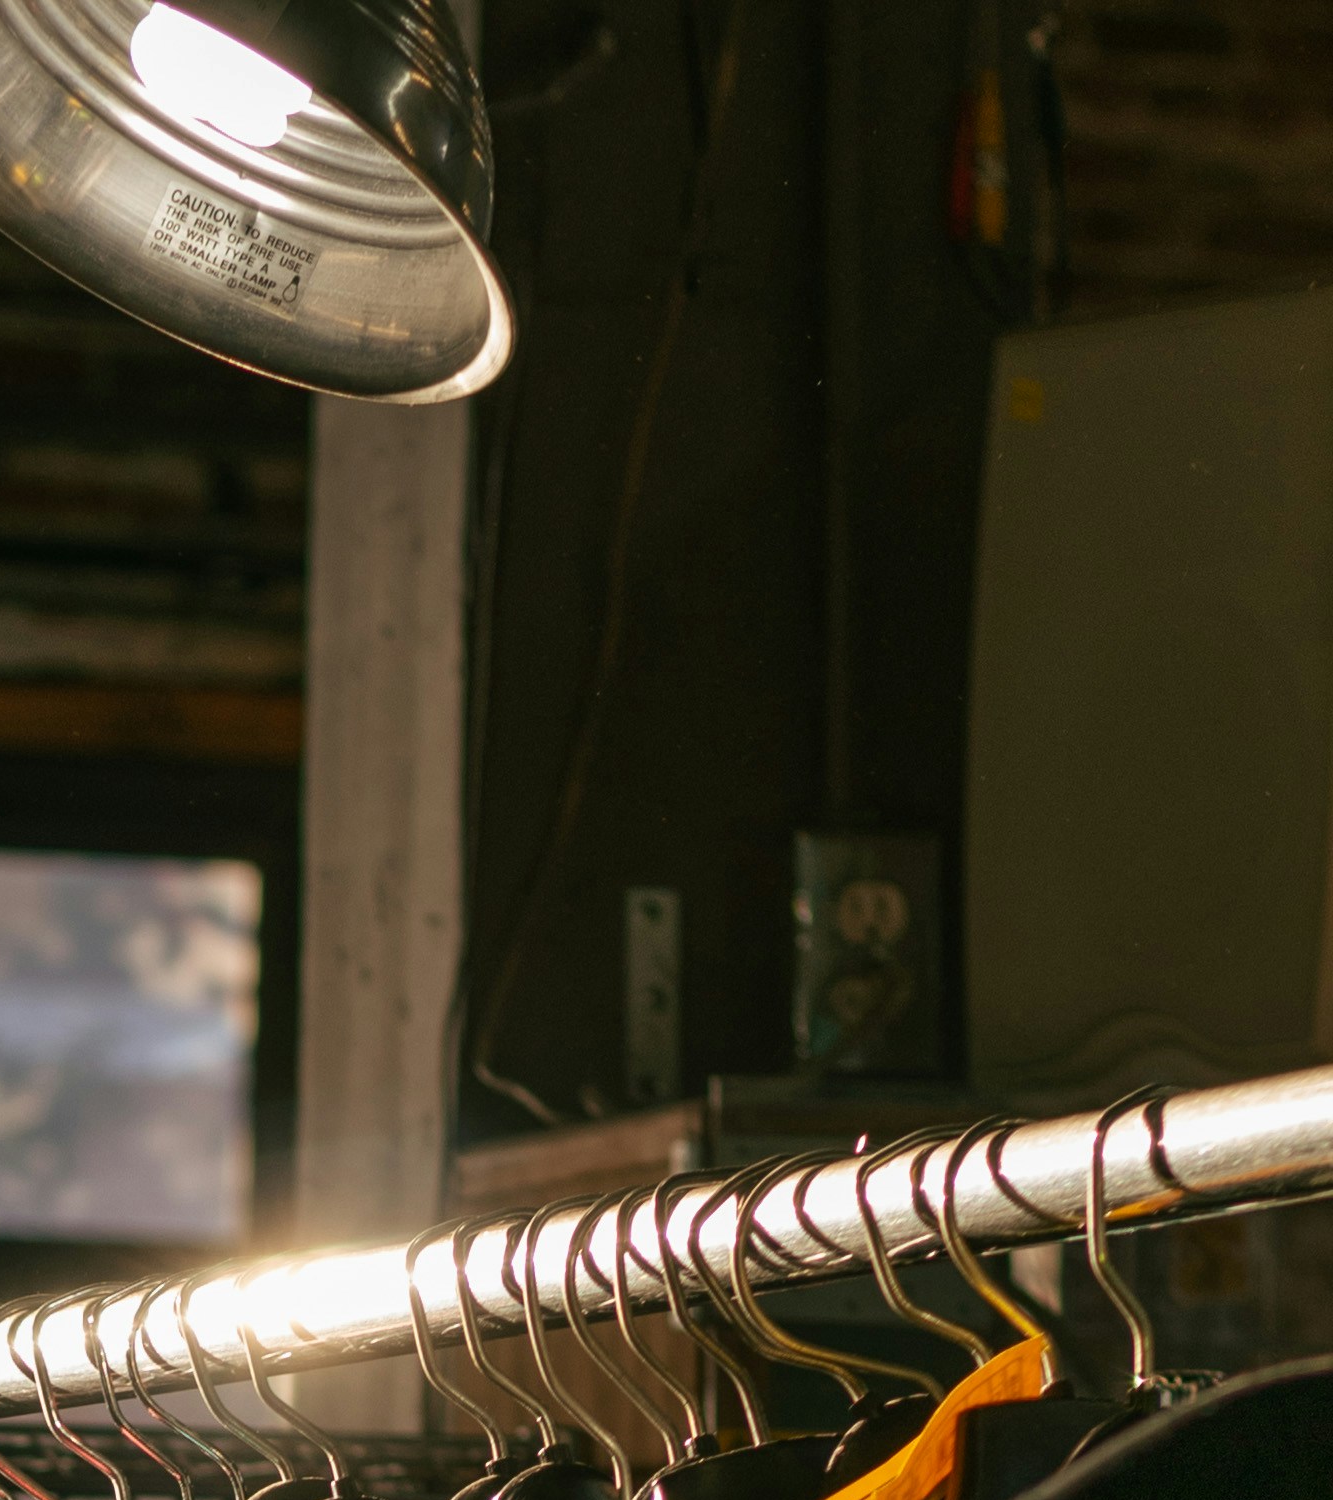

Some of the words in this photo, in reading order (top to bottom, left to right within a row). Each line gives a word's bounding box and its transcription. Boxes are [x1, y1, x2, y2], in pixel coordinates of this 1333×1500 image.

[160, 217, 181, 234] 100
[186, 228, 219, 250] WATT
[224, 246, 255, 267] TYPE
[259, 263, 268, 274] A
[166, 205, 188, 223] THE
[193, 218, 222, 237] RISK
[227, 233, 244, 246] OF
[248, 242, 275, 262] FIRE
[278, 255, 302, 274] USE
[171, 189, 239, 230] CAUTION:
[244, 224, 260, 240] TO
[265, 235, 315, 264] REDUCE
[154, 229, 173, 245] OR
[178, 241, 237, 274] SMALLER
[242, 269, 276, 290] LAMP
[205, 266, 226, 280] ONLY
